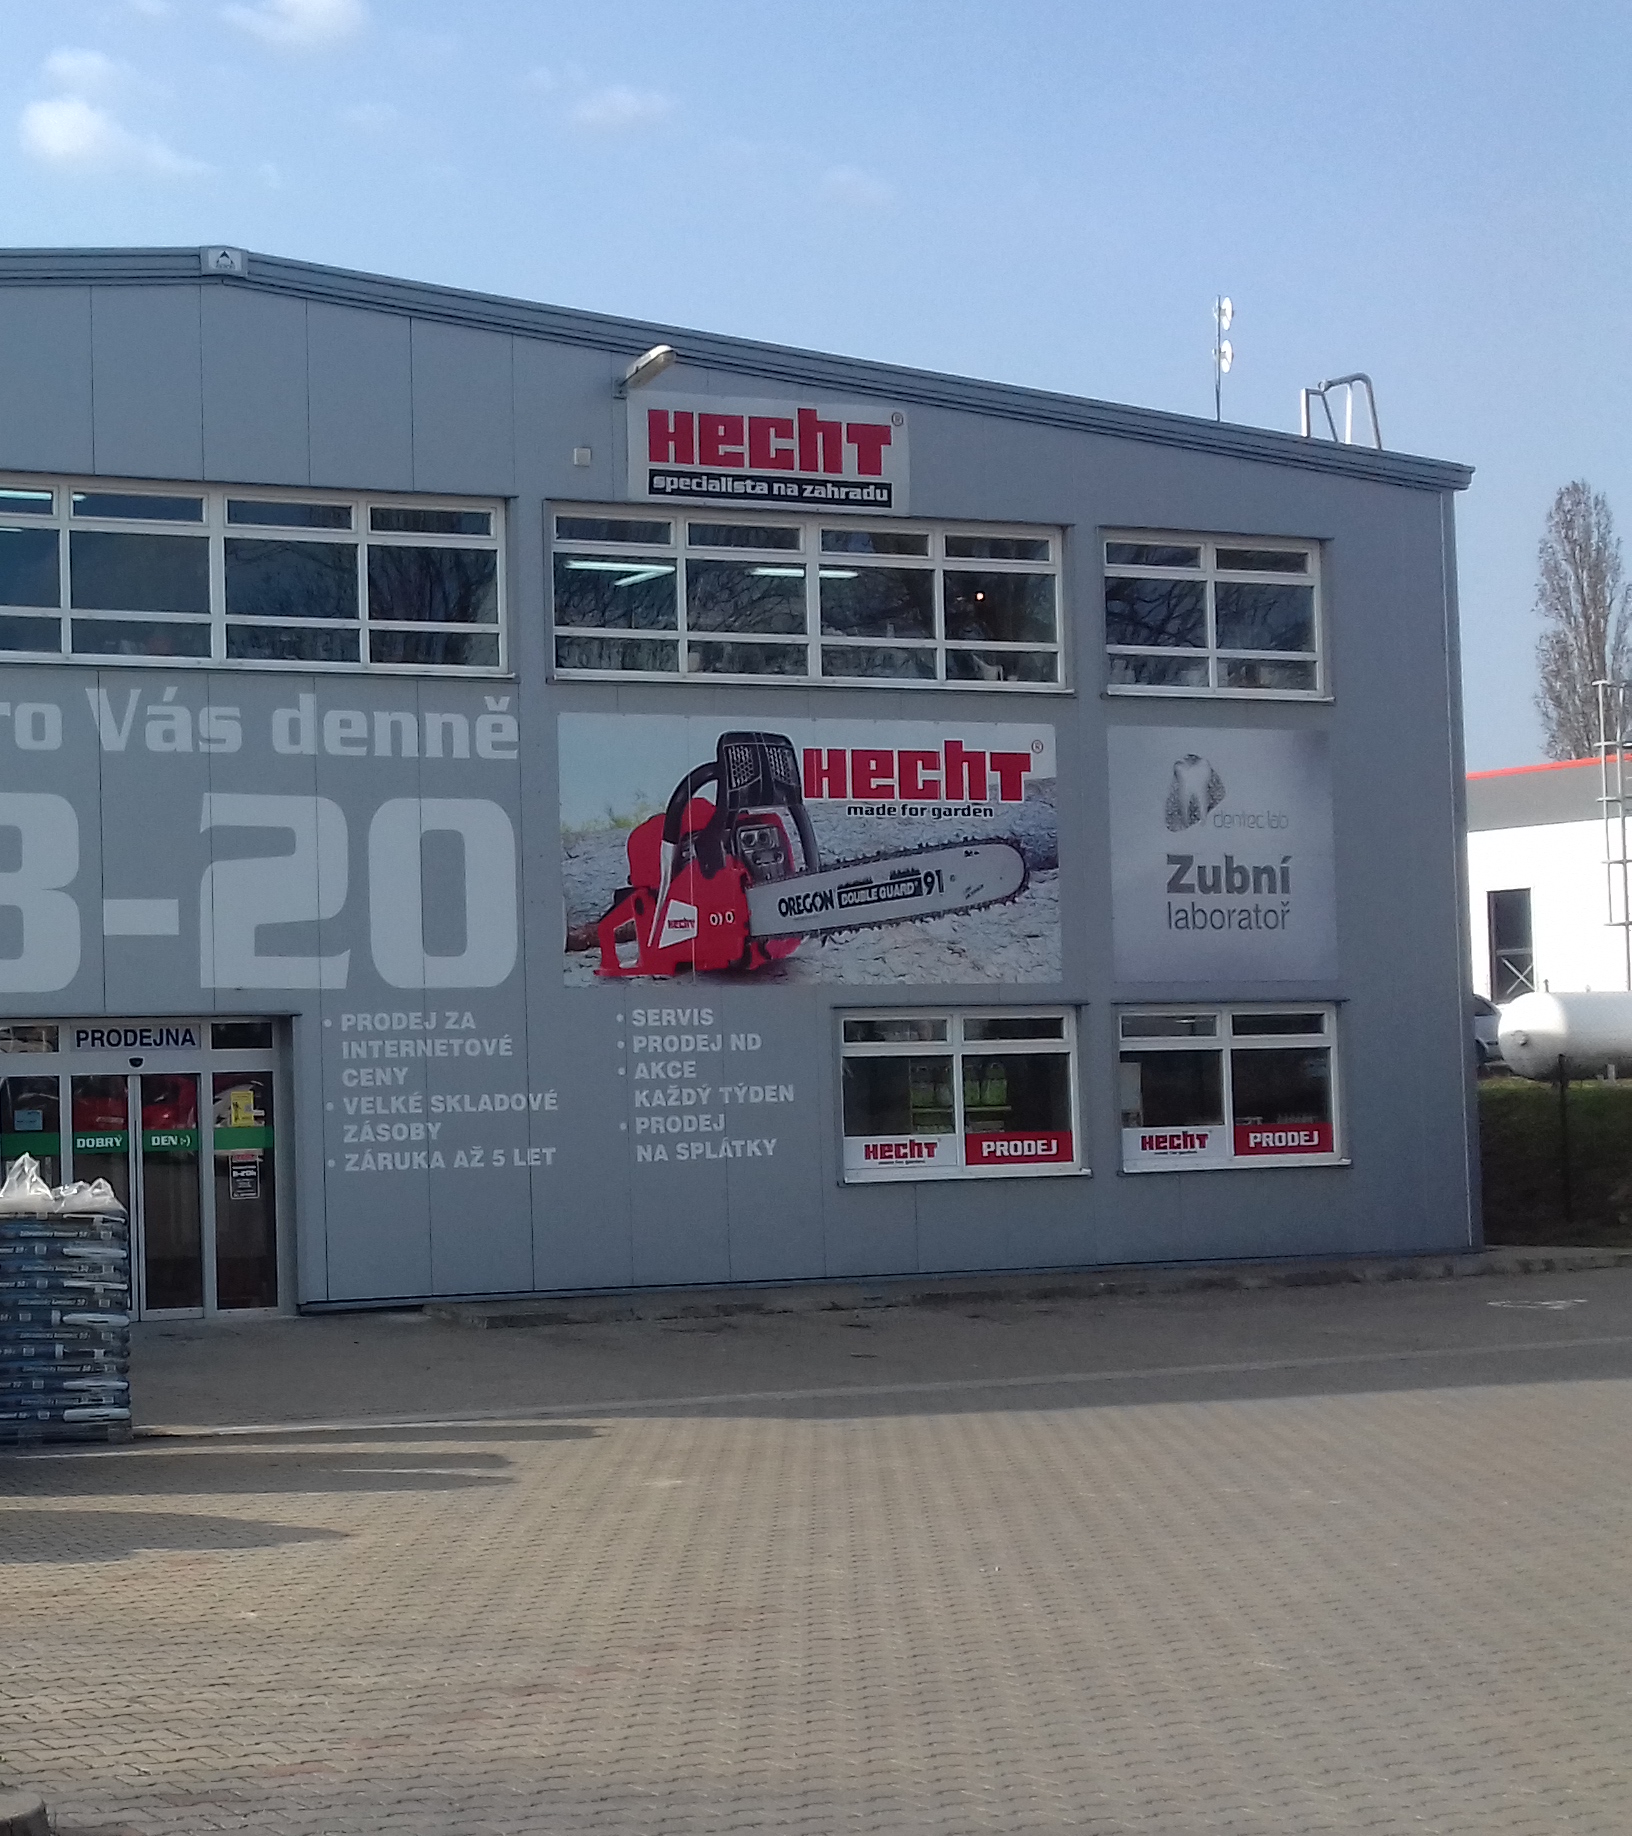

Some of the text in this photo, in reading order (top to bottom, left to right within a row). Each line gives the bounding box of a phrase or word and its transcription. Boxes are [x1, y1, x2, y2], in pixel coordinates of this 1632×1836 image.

[653, 475, 889, 502] specialista na zahradu
[86, 687, 243, 754] Vás
[271, 693, 520, 760] denně
[847, 803, 995, 820] made for garden
[1166, 853, 1293, 895] Zubní
[778, 889, 834, 917] OREGON
[923, 869, 945, 896] 91
[1167, 901, 1291, 930] laboratoř
[340, 1011, 476, 1032] PRODEJ ZA
[631, 1008, 714, 1027] SERVIS
[76, 1027, 196, 1047] PRODEJNA
[342, 1035, 513, 1059] INTERNETOVÉ
[632, 1033, 761, 1053] PRODEJ ND
[342, 1067, 409, 1087] CENY
[634, 1061, 697, 1080] AKCE
[343, 1089, 558, 1115] VELKÉ SKLADOVÉ
[634, 1082, 795, 1108] KAŽDÝ TÝDEN
[343, 1121, 442, 1143] ZÁSOBY
[635, 1114, 726, 1135] PRODEJ
[76, 1134, 123, 1149] DOBRÝ
[151, 1135, 178, 1147] DEN
[636, 1137, 778, 1162] NA SPLÁTKY
[982, 1139, 1058, 1157] PRODEJ
[1249, 1131, 1319, 1148] PRODEJ
[345, 1145, 557, 1172] ZÁRUKA AŽ 5 LET
